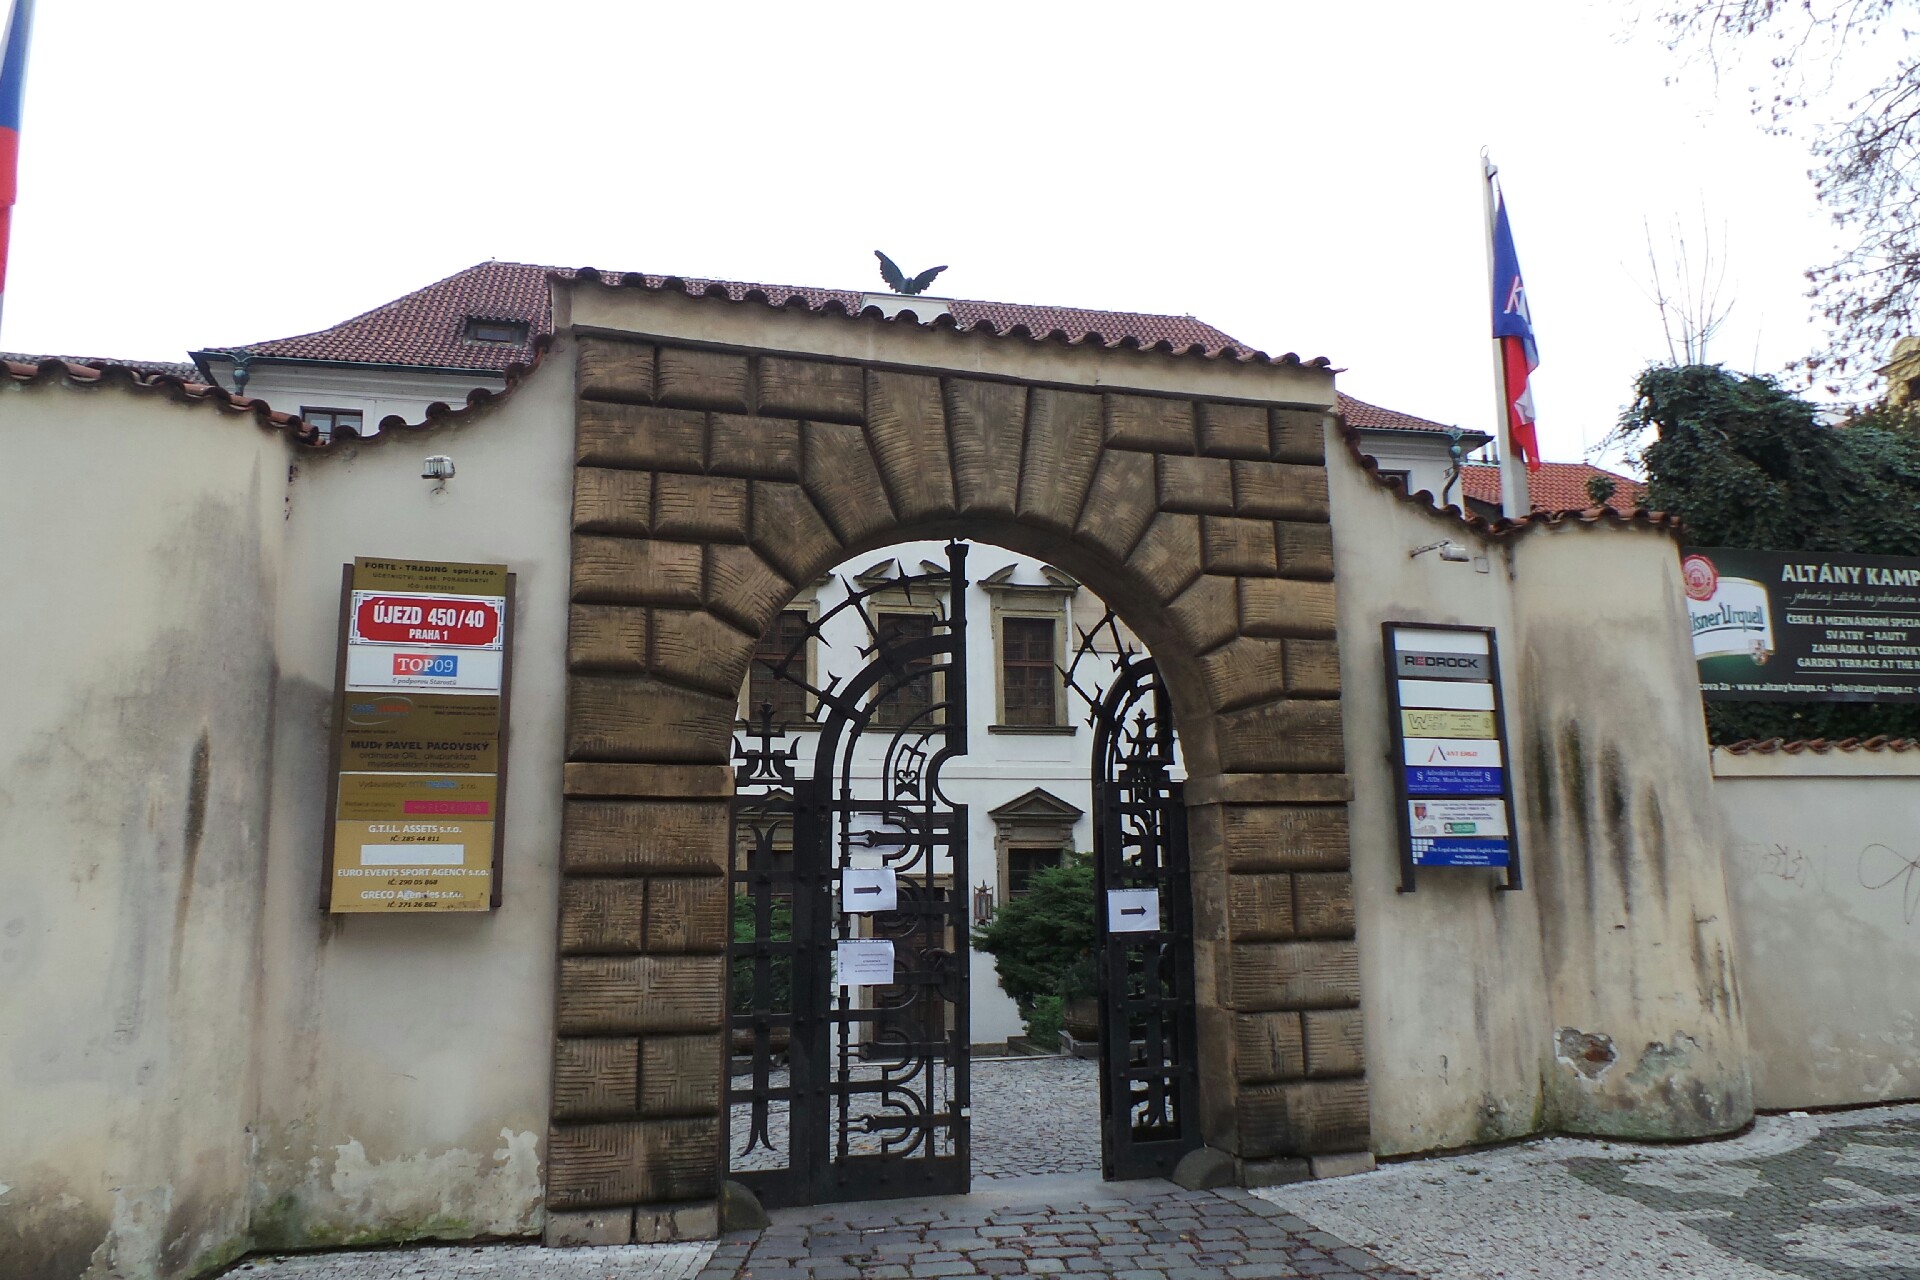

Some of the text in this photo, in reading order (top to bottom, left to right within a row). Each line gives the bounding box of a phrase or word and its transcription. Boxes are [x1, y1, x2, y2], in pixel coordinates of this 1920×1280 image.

[365, 562, 396, 571] FORTE
[406, 564, 448, 573] TRADING
[482, 568, 497, 576] r.o.
[1781, 562, 1862, 585] ALTÁNY
[373, 600, 485, 629] ÚJEZD 450/40
[1718, 602, 1764, 632] Urquell
[1786, 613, 1815, 625] ČESKÉ
[1815, 615, 1823, 625] A
[1824, 614, 1891, 627] MEZINÁRODNÍ
[408, 628, 448, 640] PRAHA 1
[1825, 630, 1865, 640] SVATBY
[1874, 631, 1908, 641] RAUTY
[1811, 642, 1867, 654] ZAHRÁDKA
[1867, 644, 1876, 654] U
[396, 658, 454, 673] TOP09
[1404, 655, 1479, 669] REDROCK
[1796, 657, 1837, 667] GARDEN
[1838, 658, 1881, 669] TERRACE
[1881, 659, 1895, 669] AT
[1895, 660, 1914, 670] THE
[397, 677, 428, 686] podporou
[429, 678, 456, 686] Starostů
[1735, 682, 1828, 694] www.altanykampa.cz
[1831, 682, 1915, 695] info@altanykampa.cz
[350, 740, 490, 751] MUDr PAVEL PACOVSKÝ
[359, 752, 400, 760] ordinace
[367, 825, 463, 834] G.T.I.L. ASSETS s.r.o.
[389, 834, 400, 842] IČ:
[401, 835, 415, 843] 285
[337, 868, 489, 878] EURO EVENTS SPORT AGENCY s.r.o.
[387, 878, 397, 886] IČ:
[360, 890, 394, 900] GRECO
[441, 891, 464, 900] s.r.o.
[386, 901, 438, 909] IČ: 271 26 862
